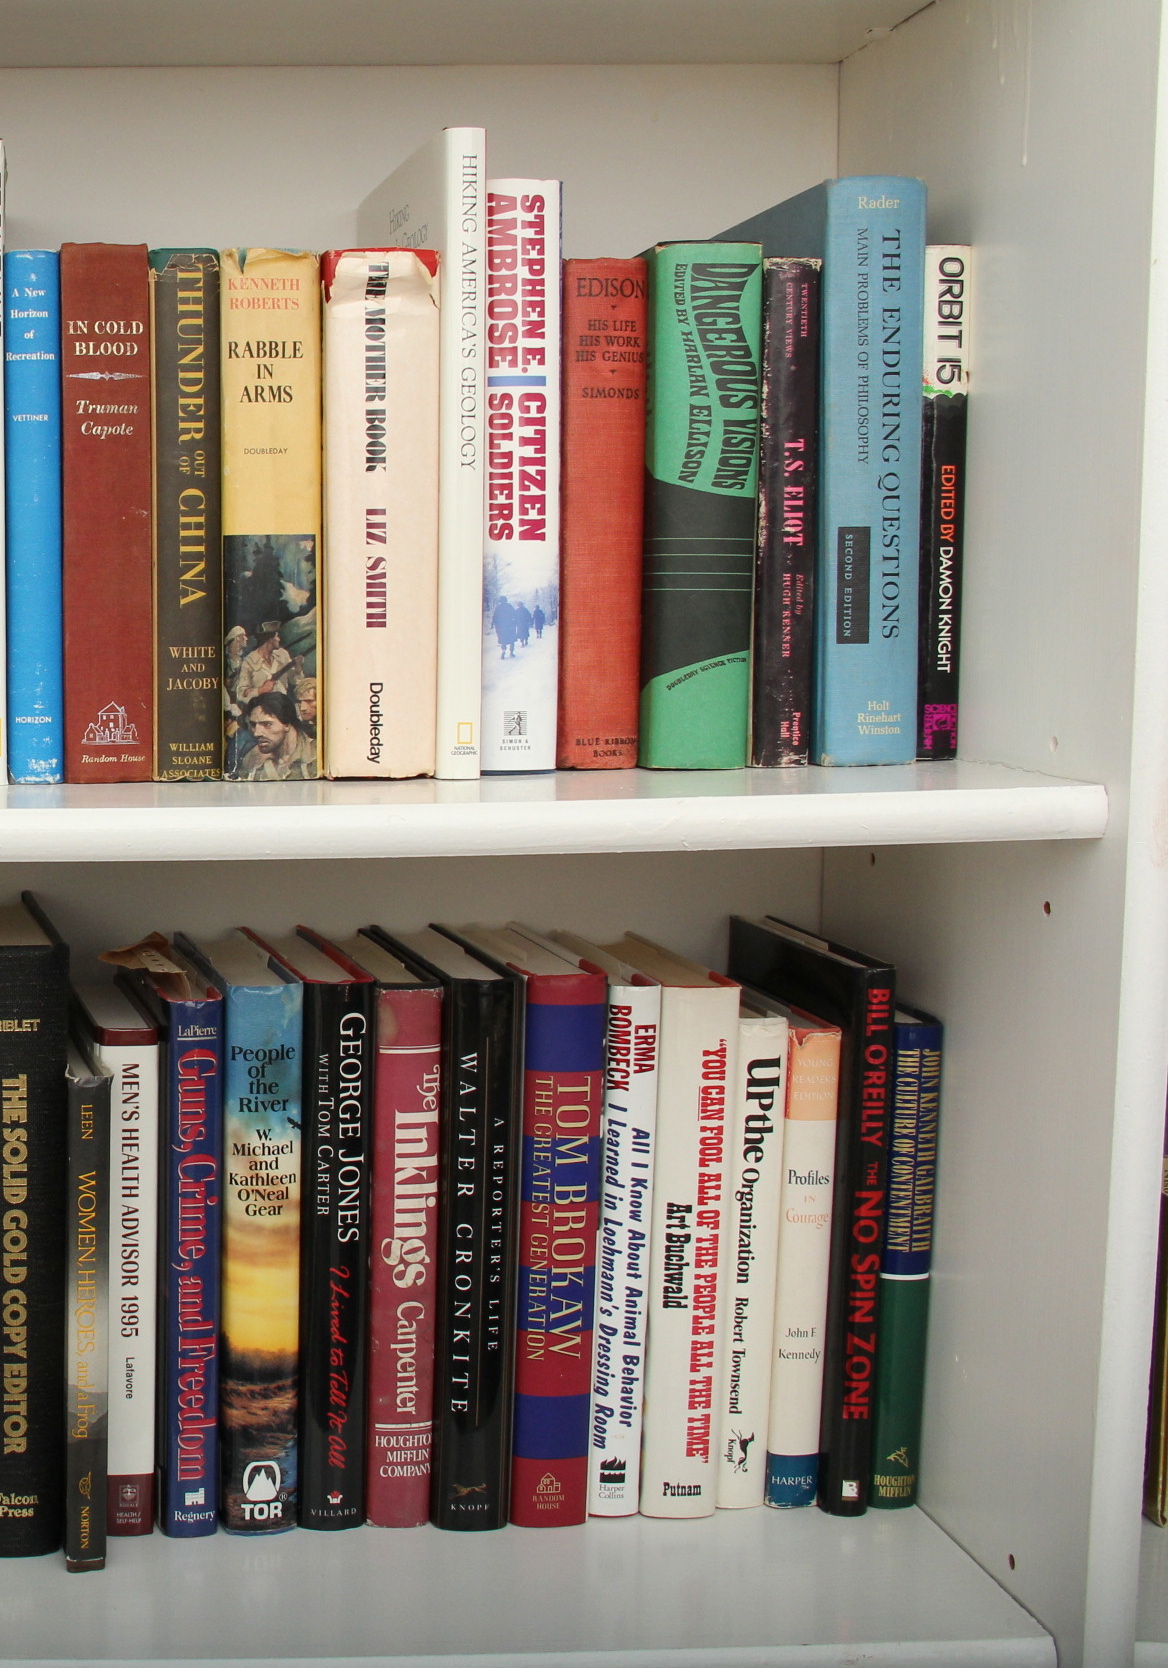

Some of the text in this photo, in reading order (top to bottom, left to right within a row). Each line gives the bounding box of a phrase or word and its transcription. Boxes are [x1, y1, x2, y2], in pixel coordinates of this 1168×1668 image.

[858, 197, 899, 208] Rader
[488, 193, 518, 369] AMBROSE
[521, 194, 546, 374] STEPHEN E.
[577, 278, 645, 299] EDISON
[460, 154, 477, 470] HIKING AMERICA'S GEOLOGY
[937, 257, 965, 384] ORBIT 15
[68, 321, 143, 335] IN COLD
[74, 342, 137, 357] BLOOD
[177, 264, 204, 444] THUNDER
[228, 341, 304, 359] RABBLE
[257, 365, 273, 379] IN
[240, 386, 293, 403] ARMS
[582, 388, 640, 399] SIMONDS
[76, 400, 138, 415] Truman
[81, 422, 133, 439] Capote
[877, 229, 901, 639] THE ENDURING QUESTIONS
[488, 392, 514, 542] SOLDIERS
[518, 392, 546, 542] CITIZEN
[179, 488, 207, 608] CHINA
[366, 508, 386, 629] LIZ SMITH
[938, 466, 955, 672] EDITED BY DAMON KNIGHT
[843, 535, 853, 637] SECOND EDITION
[170, 647, 215, 658] WHITE
[167, 678, 219, 691] JACOBY
[367, 682, 383, 764] Doubleday
[178, 1026, 216, 1036] LaPierre
[231, 1045, 295, 1062] People
[606, 1005, 632, 1091] BOMBECK
[634, 1024, 656, 1074] ERMA
[248, 1063, 266, 1079] of
[861, 989, 890, 1146] BILL O'REILLY
[249, 1079, 279, 1094] the
[239, 1098, 288, 1112] River
[338, 1012, 366, 1242] GEORGE JONES
[232, 1142, 293, 1156] Michael
[229, 1173, 296, 1186] Kathleen
[121, 1064, 140, 1338] MEN'S HEALTH ADVISOR 1995
[238, 1188, 289, 1201] O'Neal
[245, 1204, 283, 1217] Gear
[548, 1076, 590, 1359] TOM BROKAW
[451, 1052, 478, 1412] WALTER CRONKITE
[2, 1074, 28, 1454] THE SOLID GOLD COPY EDITOR
[842, 1254, 879, 1420] SPIN ZONE
[391, 1301, 424, 1415] Carpenter
[729, 1297, 749, 1414] Robert Townsend
[778, 1349, 820, 1362] Kennedy
[126, 1358, 134, 1399] Lafavore
[663, 1482, 701, 1496] Putnam
[772, 1475, 812, 1485] HARPER
[174, 1510, 214, 1522] Regnery
[241, 1503, 282, 1520] TOR
[311, 1508, 356, 1516] VILLARD
